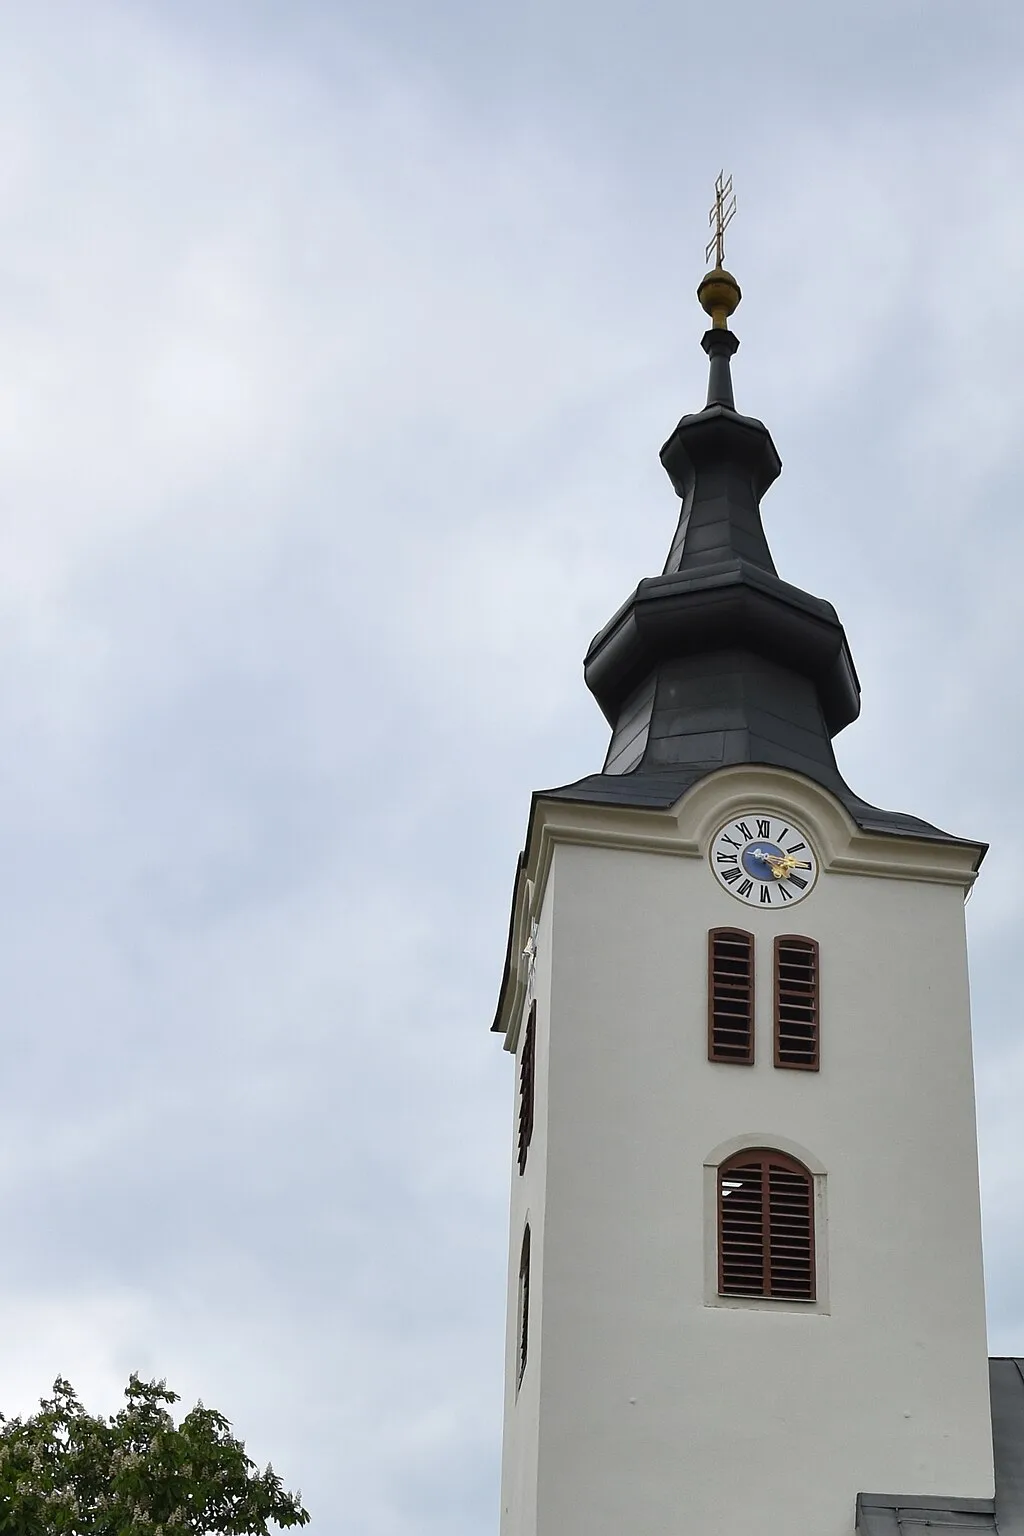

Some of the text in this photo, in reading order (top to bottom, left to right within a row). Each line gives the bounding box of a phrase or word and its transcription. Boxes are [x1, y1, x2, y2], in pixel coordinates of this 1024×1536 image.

[735, 822, 753, 842] XI
[756, 820, 770, 838] XII
[777, 828, 789, 842] I
[721, 834, 742, 850] X
[787, 842, 805, 854] II
[717, 852, 738, 863] IX
[721, 867, 743, 884] VIII
[737, 879, 754, 898] VII
[760, 885, 771, 903] VI
[778, 883, 793, 901] V
